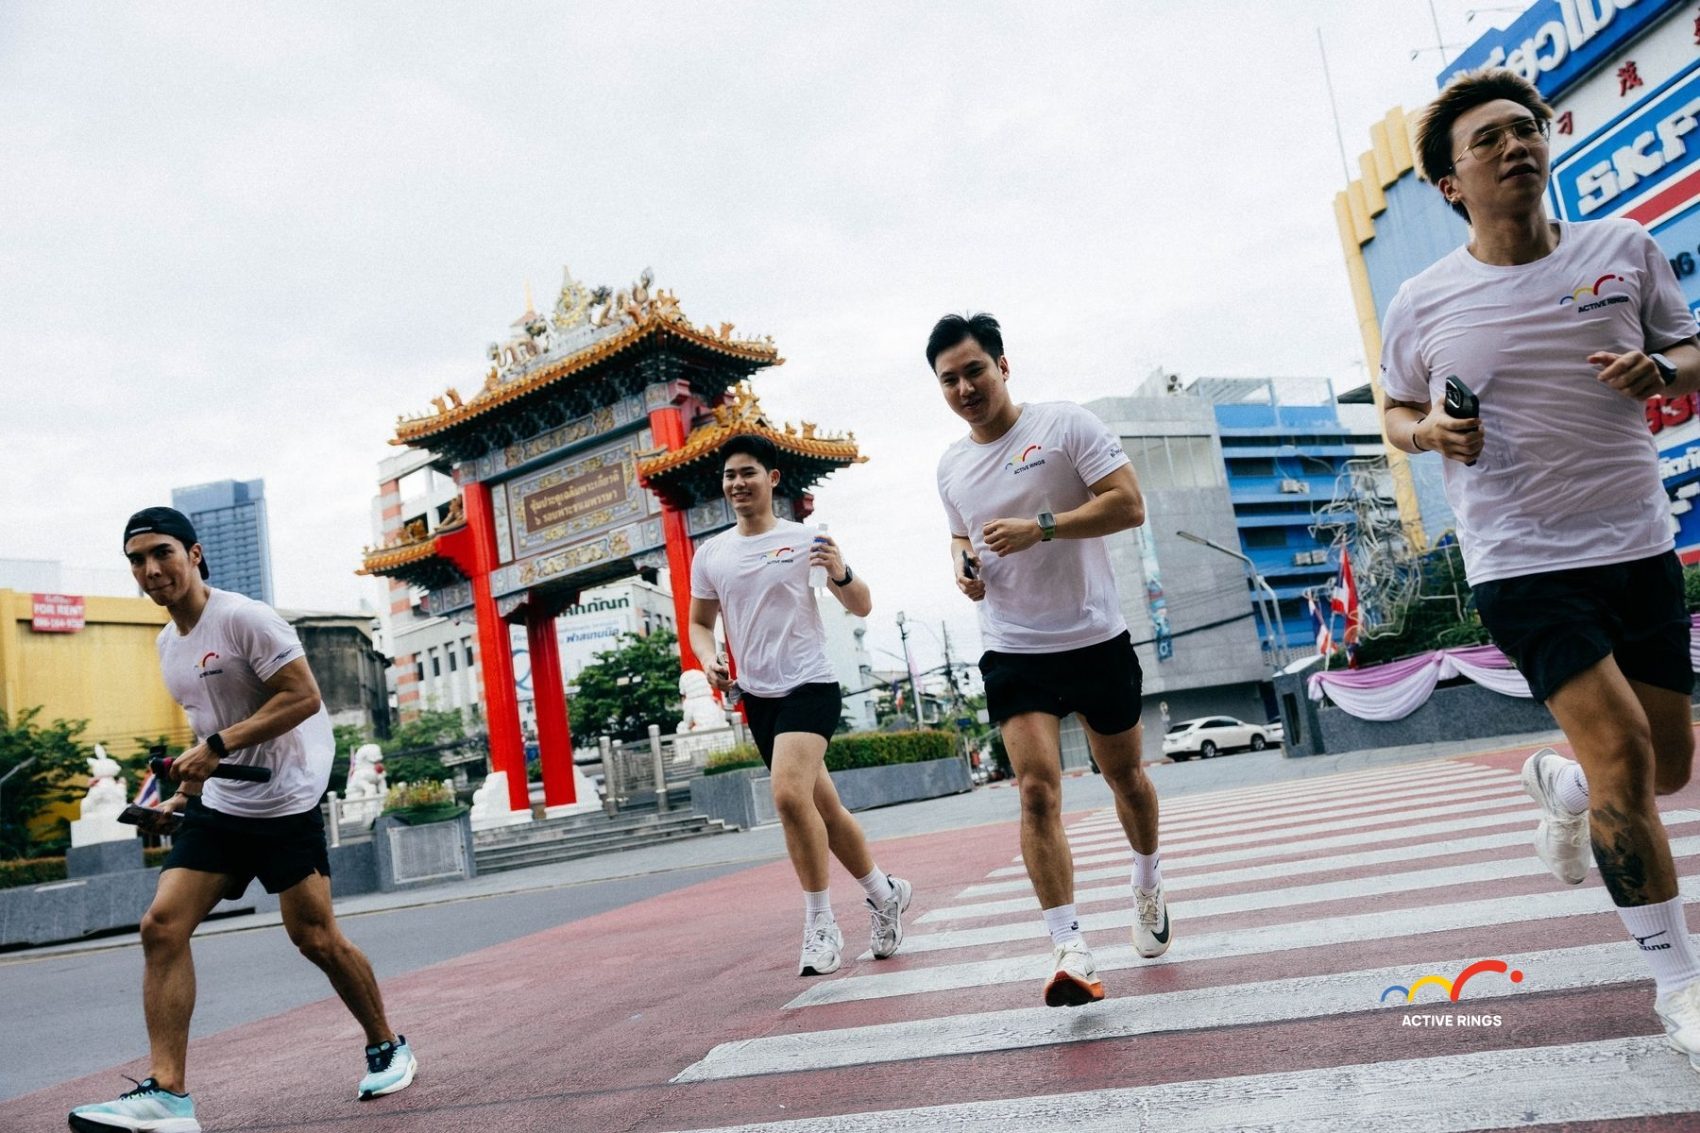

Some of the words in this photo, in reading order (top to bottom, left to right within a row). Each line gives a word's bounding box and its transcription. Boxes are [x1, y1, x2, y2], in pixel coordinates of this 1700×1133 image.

[1576, 97, 1700, 216] SKF
[1578, 300, 1606, 313] ACTIVE
[34, 603, 55, 615] FOR
[57, 604, 84, 617] RENT
